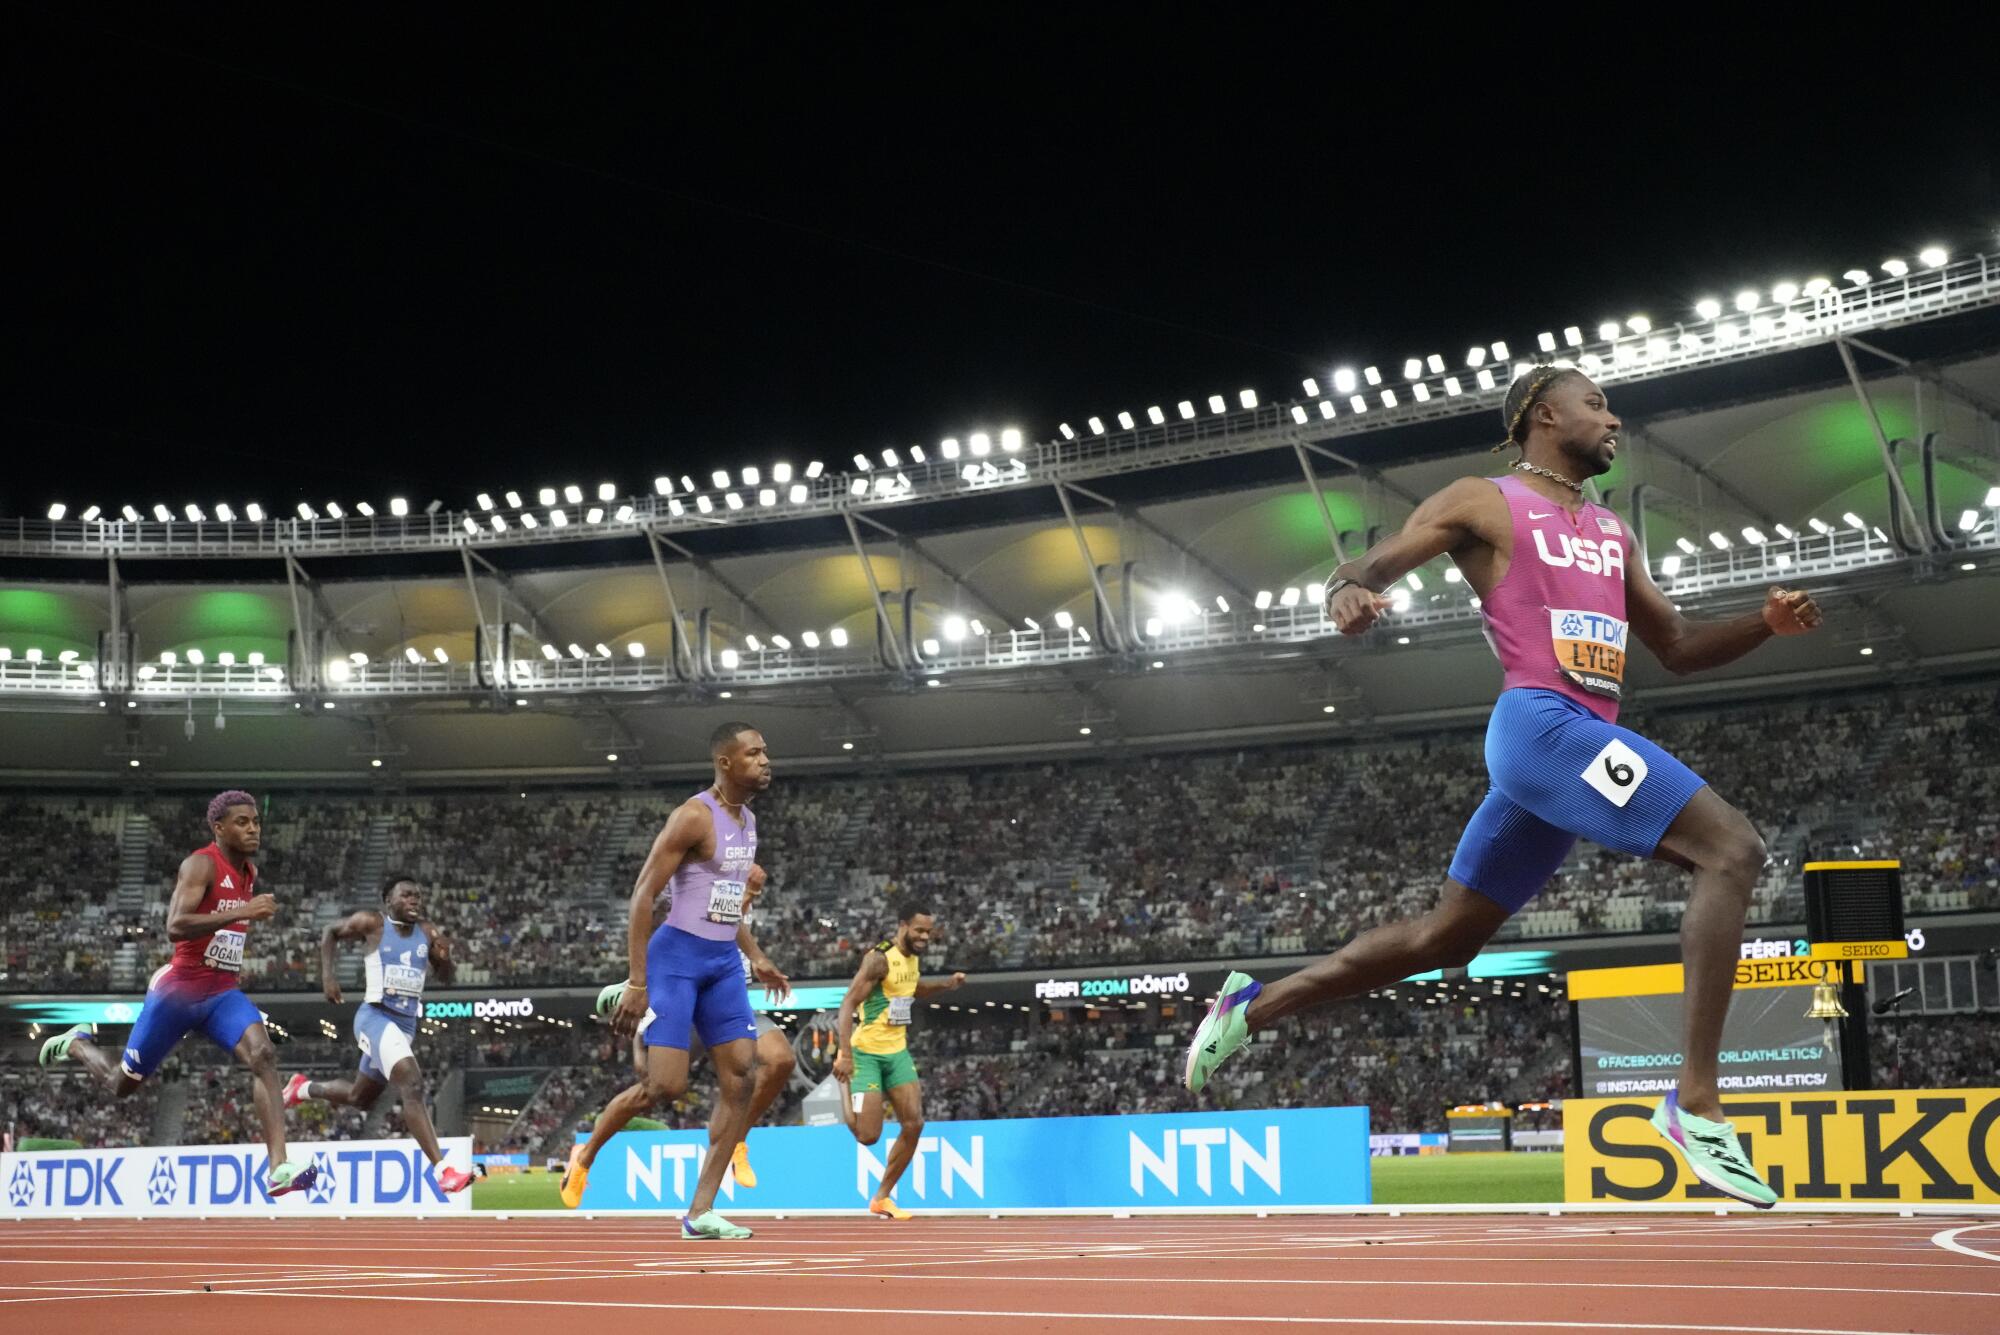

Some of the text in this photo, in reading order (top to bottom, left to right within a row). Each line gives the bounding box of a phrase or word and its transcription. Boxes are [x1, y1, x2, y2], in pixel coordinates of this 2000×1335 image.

[1532, 529, 1624, 580] USA
[1584, 615, 1623, 647] TDK
[1605, 755, 1634, 787] 6
[1740, 938, 1792, 960] FÉRFI
[1841, 944, 1890, 957] SEIKO
[1034, 978, 1080, 999] FÉRFI
[1081, 978, 1129, 997] 200M
[1735, 961, 1828, 984] SEIKO
[425, 1001, 473, 1018] 200M
[337, 1148, 450, 1204] TDK
[857, 1136, 984, 1201] NTN
[1129, 1125, 1281, 1197] NTN
[36, 1157, 124, 1206] TDK
[178, 1154, 277, 1205] TDK
